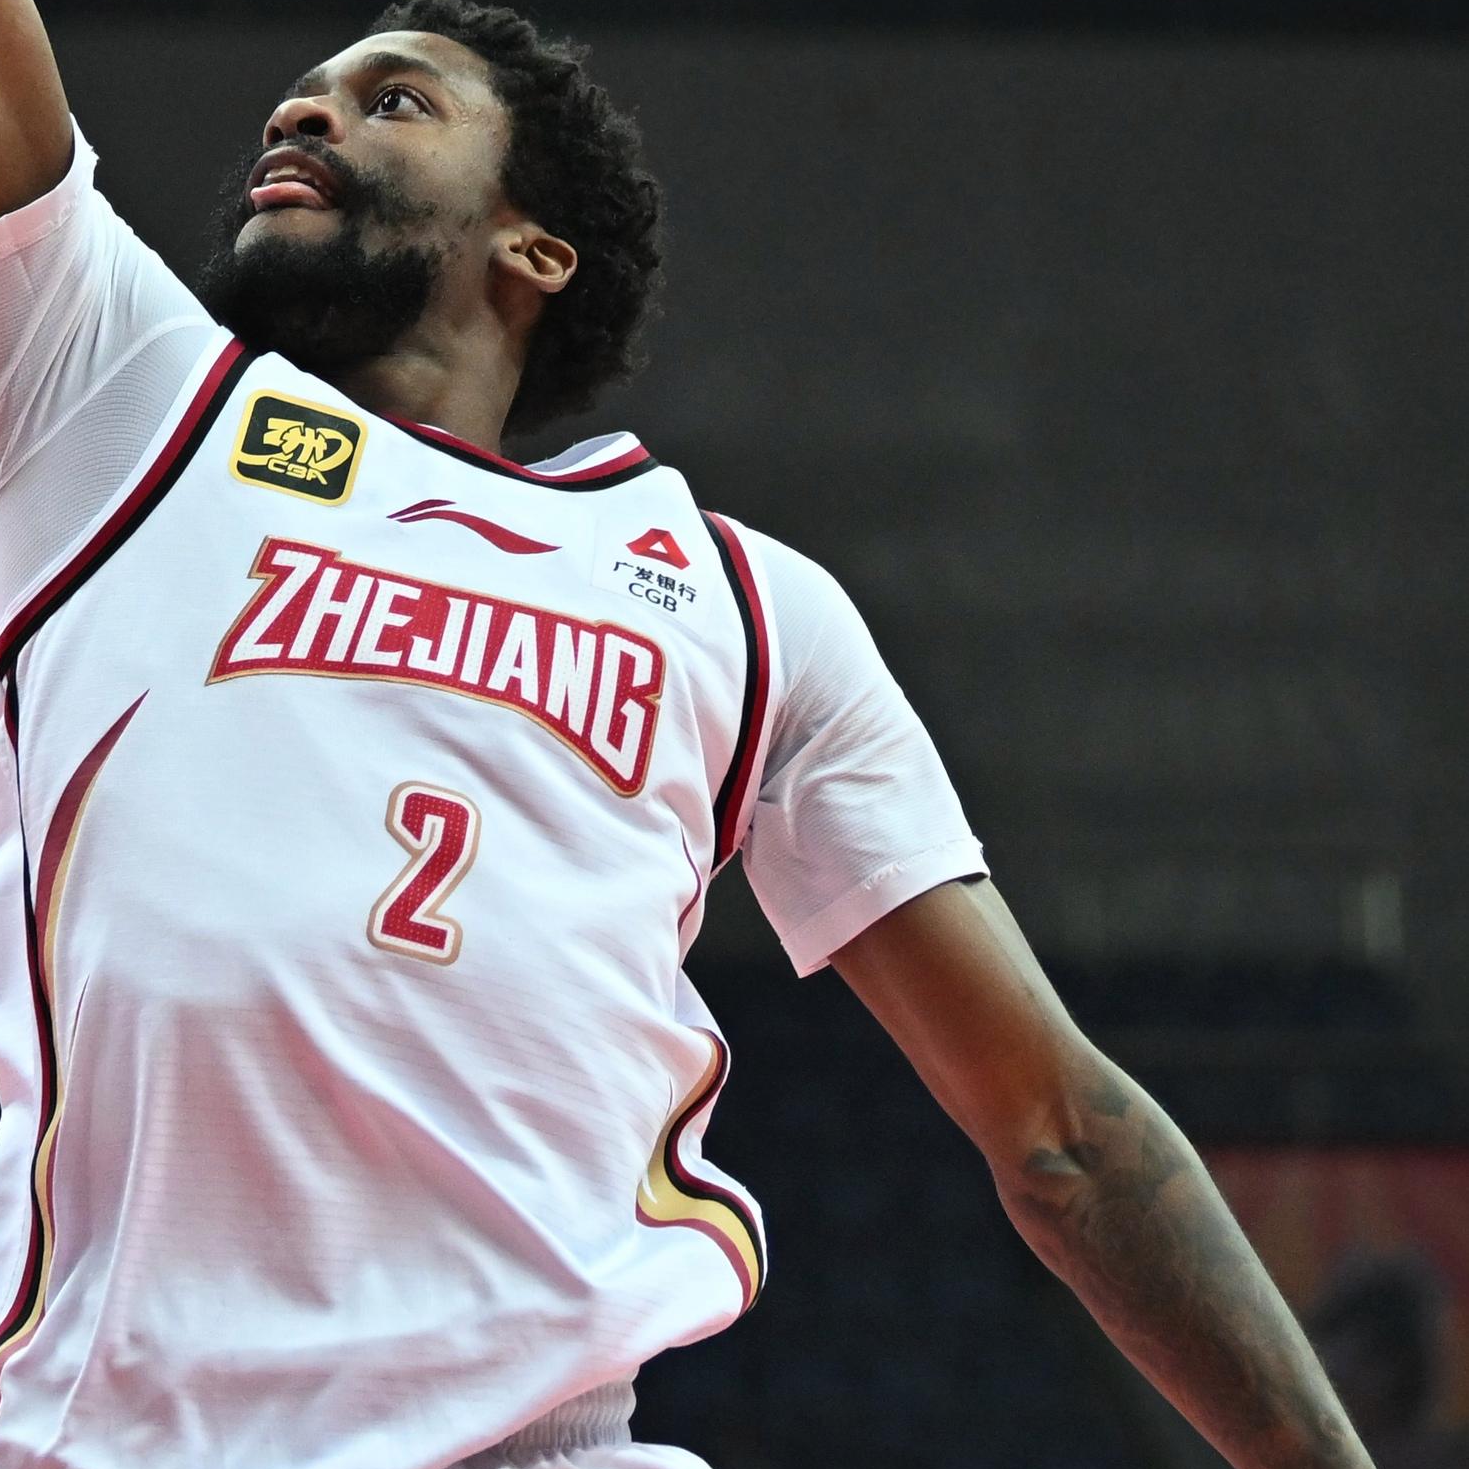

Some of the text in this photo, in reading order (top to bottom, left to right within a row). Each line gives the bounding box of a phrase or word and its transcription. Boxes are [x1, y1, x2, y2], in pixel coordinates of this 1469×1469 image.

[613, 561, 697, 604] 广发银行
[628, 582, 678, 613] CGB
[227, 546, 658, 783] ZHEJIANG
[370, 783, 477, 962] 2
